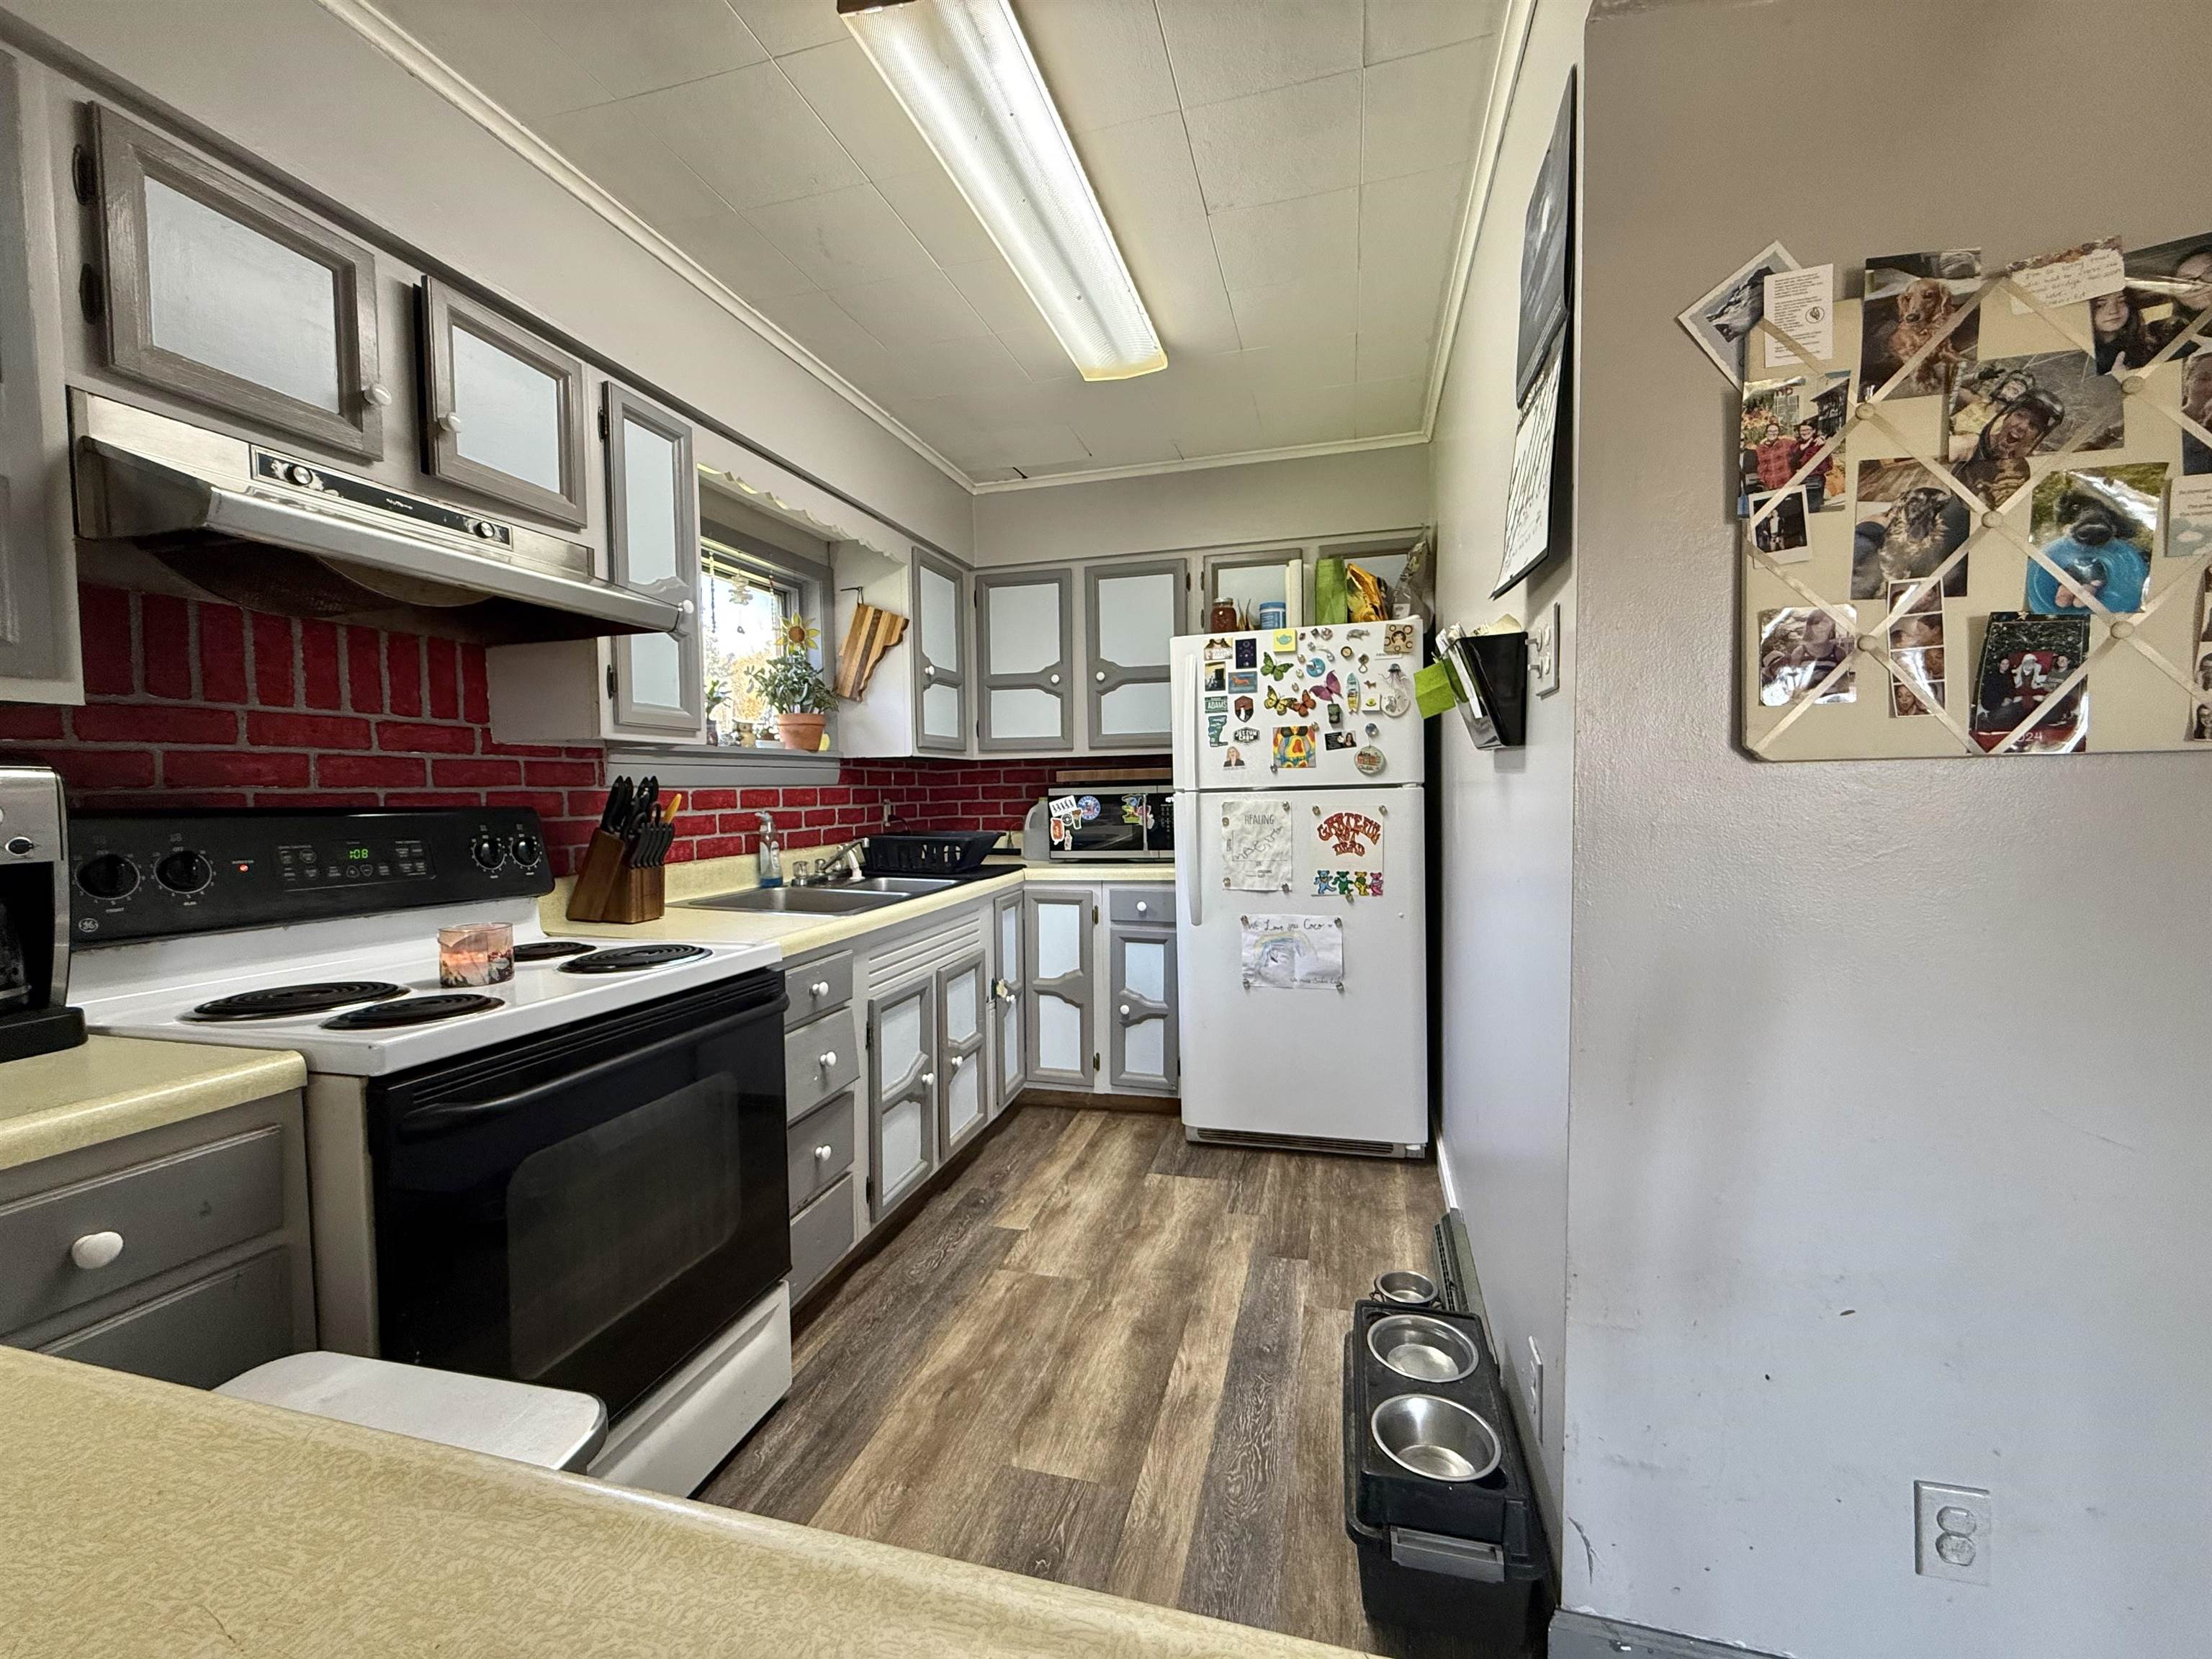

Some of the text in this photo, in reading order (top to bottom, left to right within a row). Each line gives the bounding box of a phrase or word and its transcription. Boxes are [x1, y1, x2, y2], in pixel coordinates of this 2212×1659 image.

[1208, 701, 1227, 709] ADAMS
[1244, 814, 1274, 825] HEALING
[1316, 812, 1382, 845] GRATEFUL
[1332, 841, 1366, 857] DEAD
